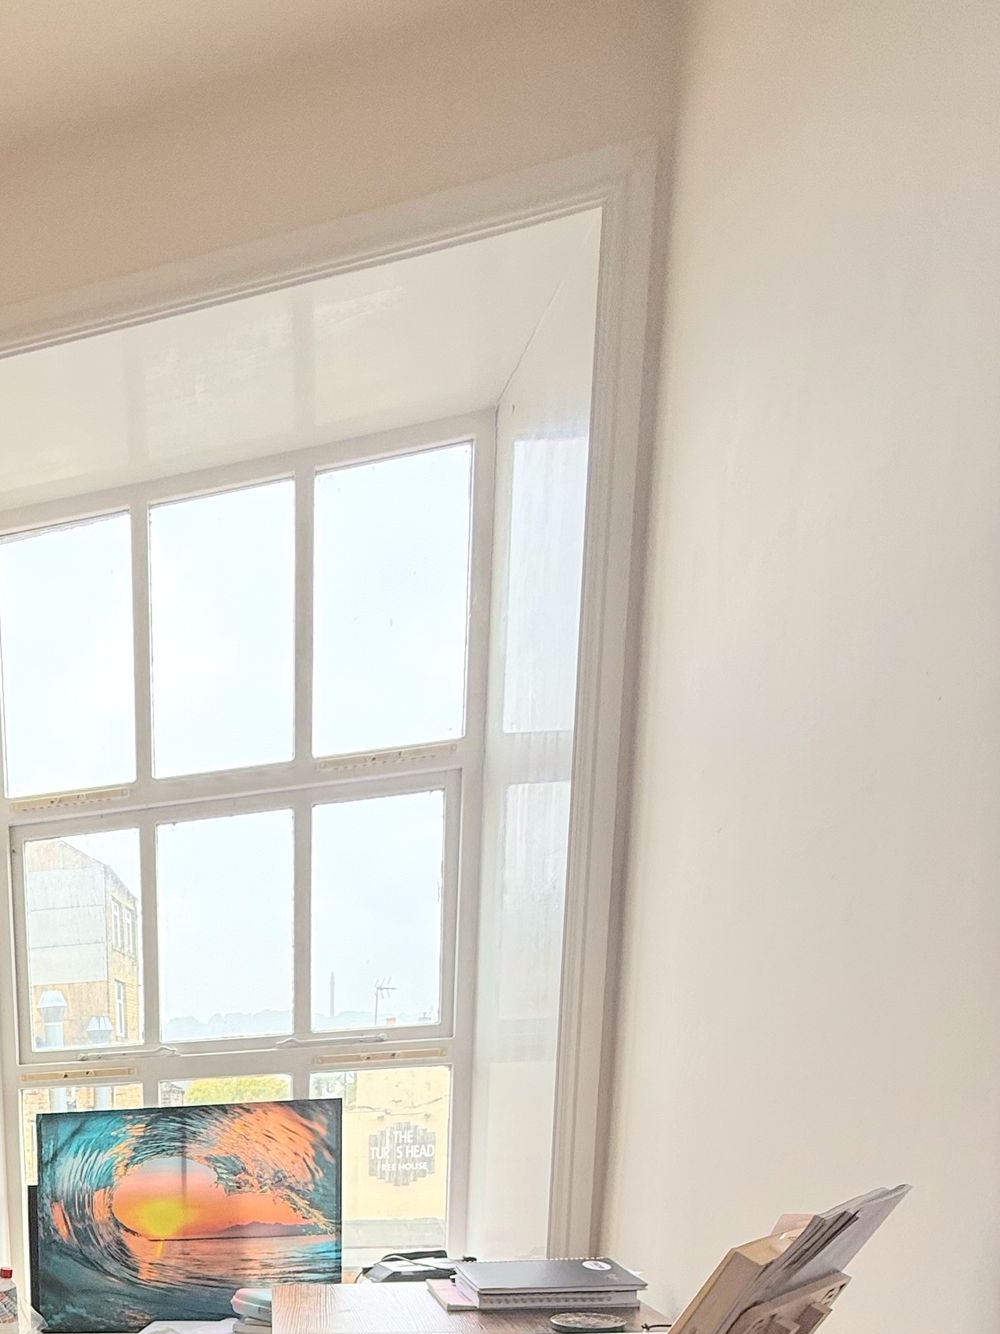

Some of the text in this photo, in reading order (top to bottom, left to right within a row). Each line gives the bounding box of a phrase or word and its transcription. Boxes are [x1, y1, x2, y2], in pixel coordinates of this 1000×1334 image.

[393, 1130, 414, 1144] THE
[406, 1144, 435, 1158] HEAD
[377, 1161, 428, 1172] FREE HOUSE
